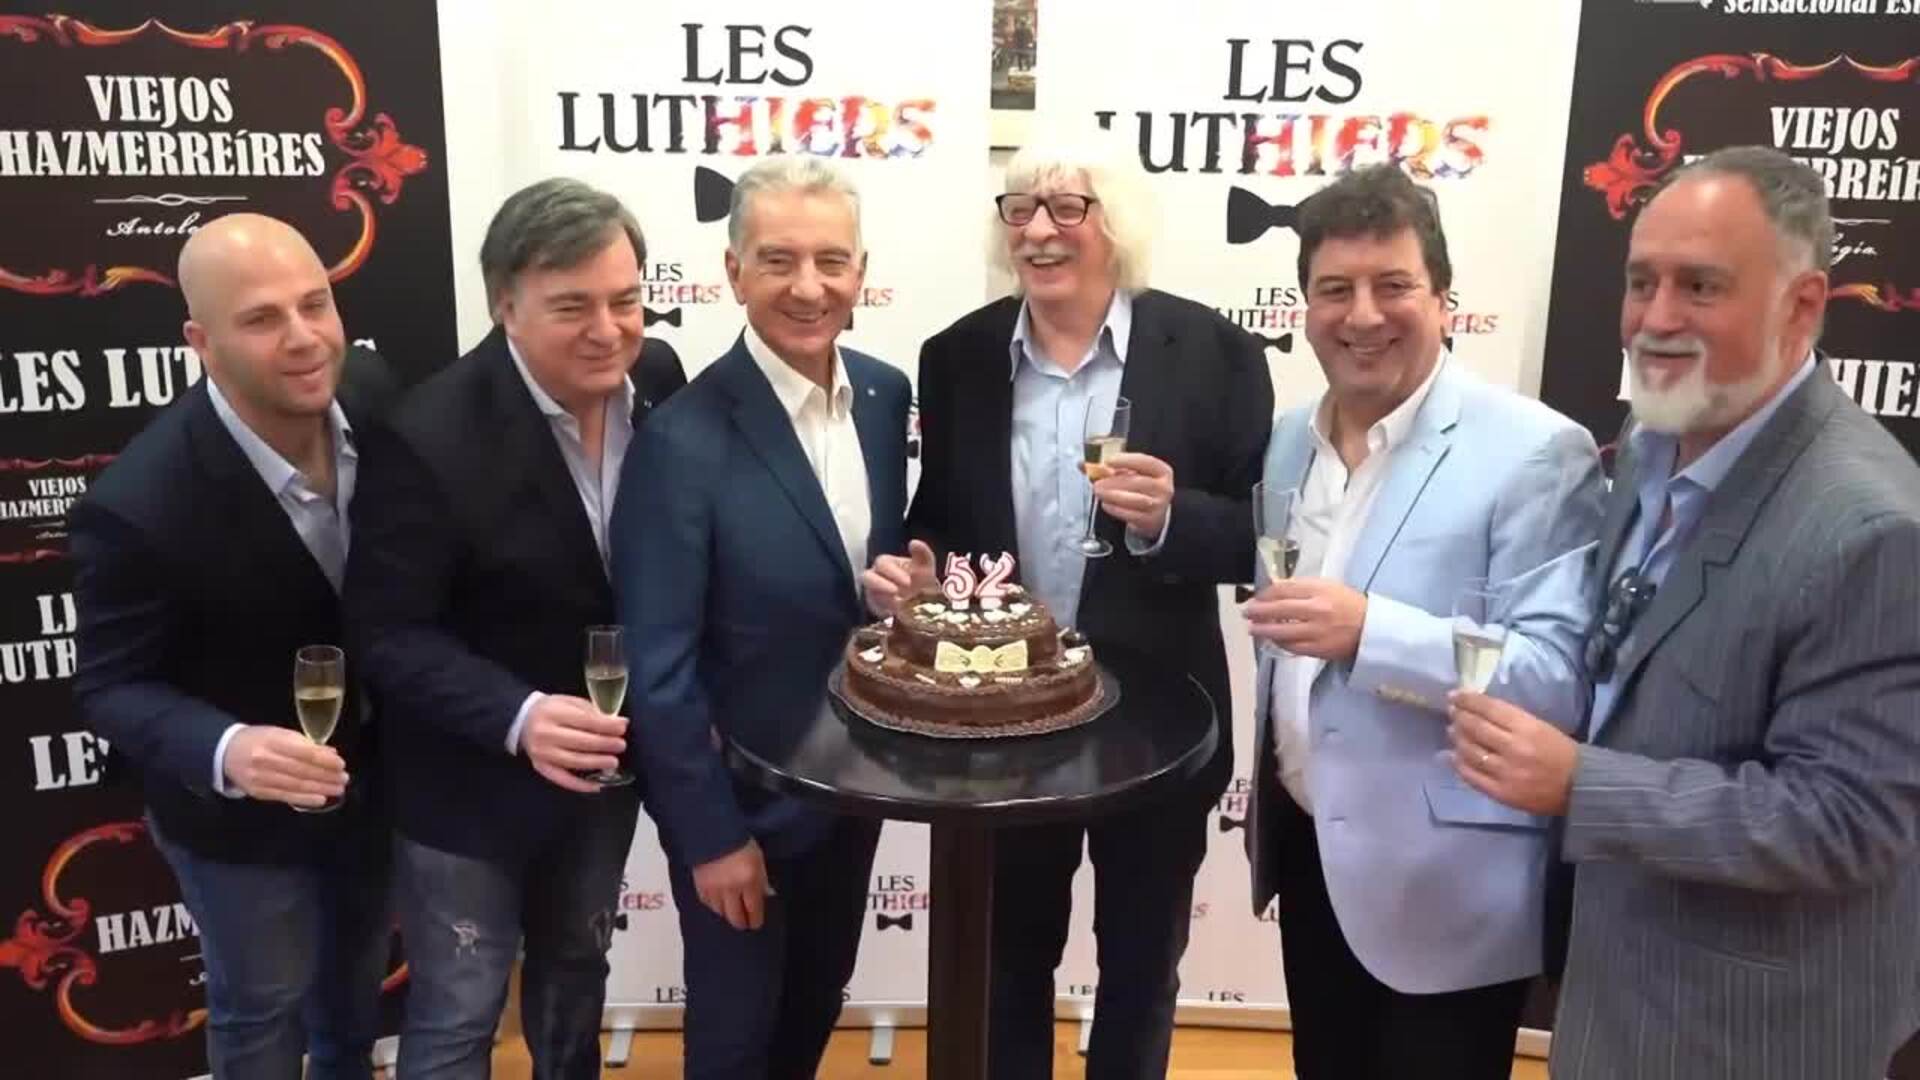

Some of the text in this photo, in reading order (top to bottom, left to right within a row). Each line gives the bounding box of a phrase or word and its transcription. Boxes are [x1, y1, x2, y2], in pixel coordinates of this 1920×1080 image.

[681, 23, 814, 86] LES
[1223, 38, 1363, 104] LES
[86, 75, 234, 128] VIEJOS
[557, 91, 937, 158] LUTHIERS
[1094, 111, 1490, 179] UTHIERS
[1770, 106, 1901, 155] VIEJOS
[641, 263, 683, 282] LES
[641, 284, 722, 304] HIERS
[1255, 287, 1297, 307] LES
[103, 346, 202, 407] LUT
[28, 476, 87, 497] VIEJOS
[943, 551, 1016, 608] 52
[29, 731, 110, 790] LE
[878, 875, 914, 892] LES
[96, 902, 201, 954] HAZM
